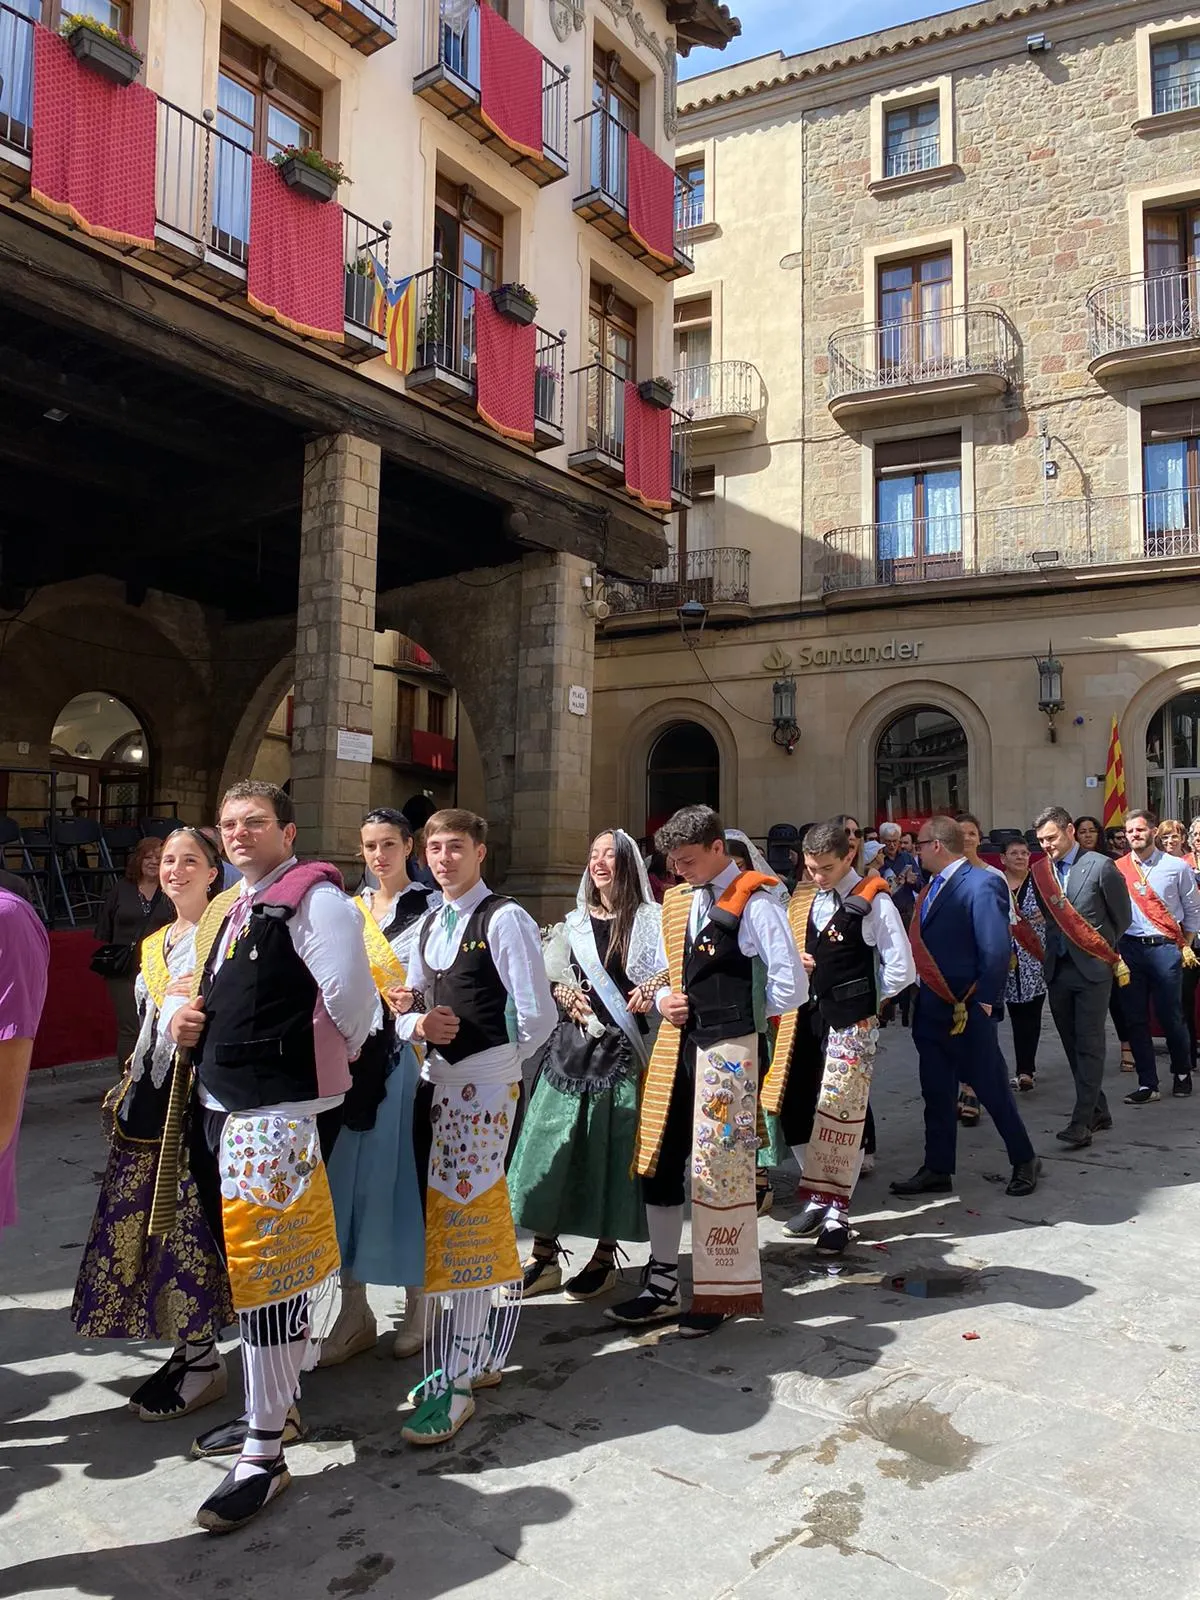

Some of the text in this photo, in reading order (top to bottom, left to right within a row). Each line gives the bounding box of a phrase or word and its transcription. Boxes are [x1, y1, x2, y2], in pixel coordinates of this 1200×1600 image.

[800, 638, 923, 667] Santander
[819, 1127, 857, 1146] HEREU
[443, 1207, 490, 1228] Hereu
[715, 1258, 734, 1266] 2023
[269, 1265, 315, 1295] 2023
[451, 1264, 494, 1284] 2023
